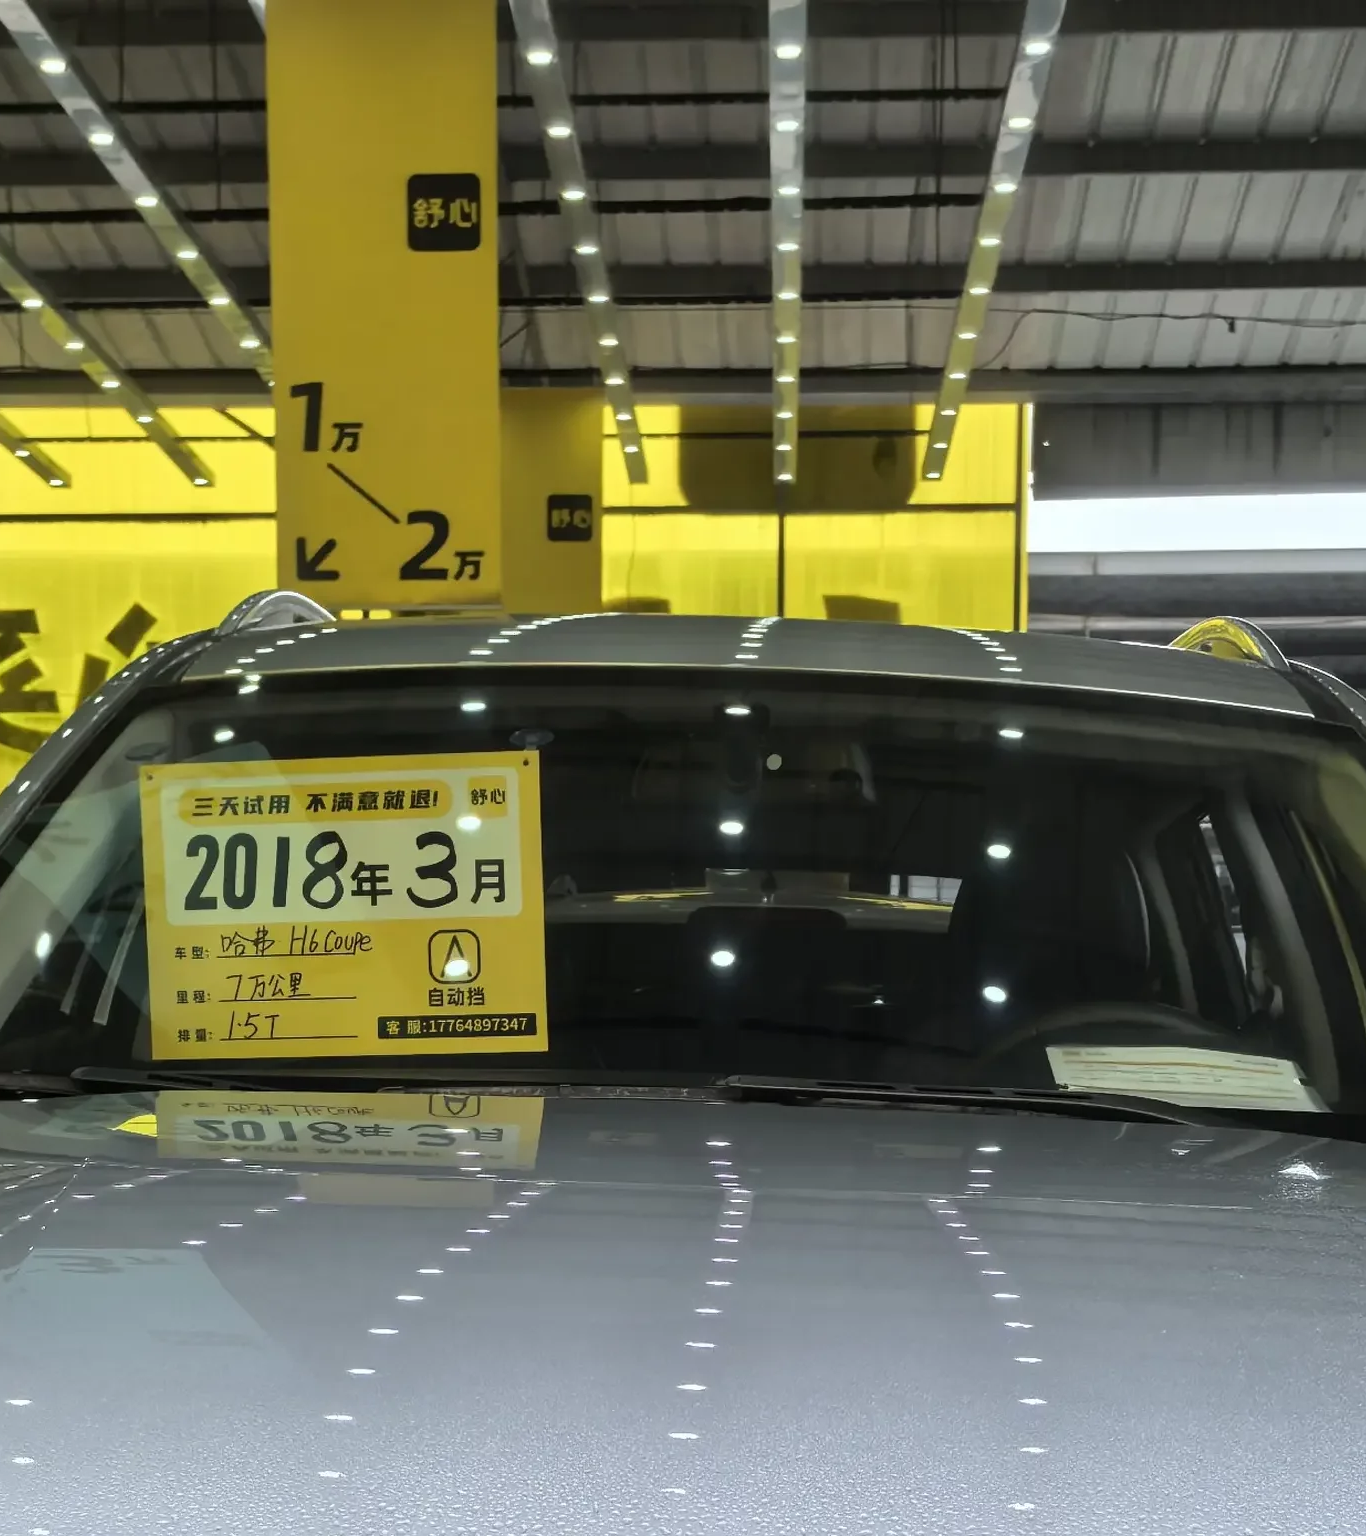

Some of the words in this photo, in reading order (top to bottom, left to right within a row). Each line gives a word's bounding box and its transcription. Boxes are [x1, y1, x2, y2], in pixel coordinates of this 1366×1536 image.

[413, 197, 478, 230] 舒心
[289, 381, 363, 453] 1万
[398, 511, 485, 581] 2万
[192, 794, 290, 817] 三天试用
[306, 789, 438, 813] 不满意就退!
[471, 788, 506, 806] 舒心
[221, 925, 275, 956] 哈弗
[226, 972, 311, 1001] 7万公里
[429, 986, 485, 1006] 自动挡
